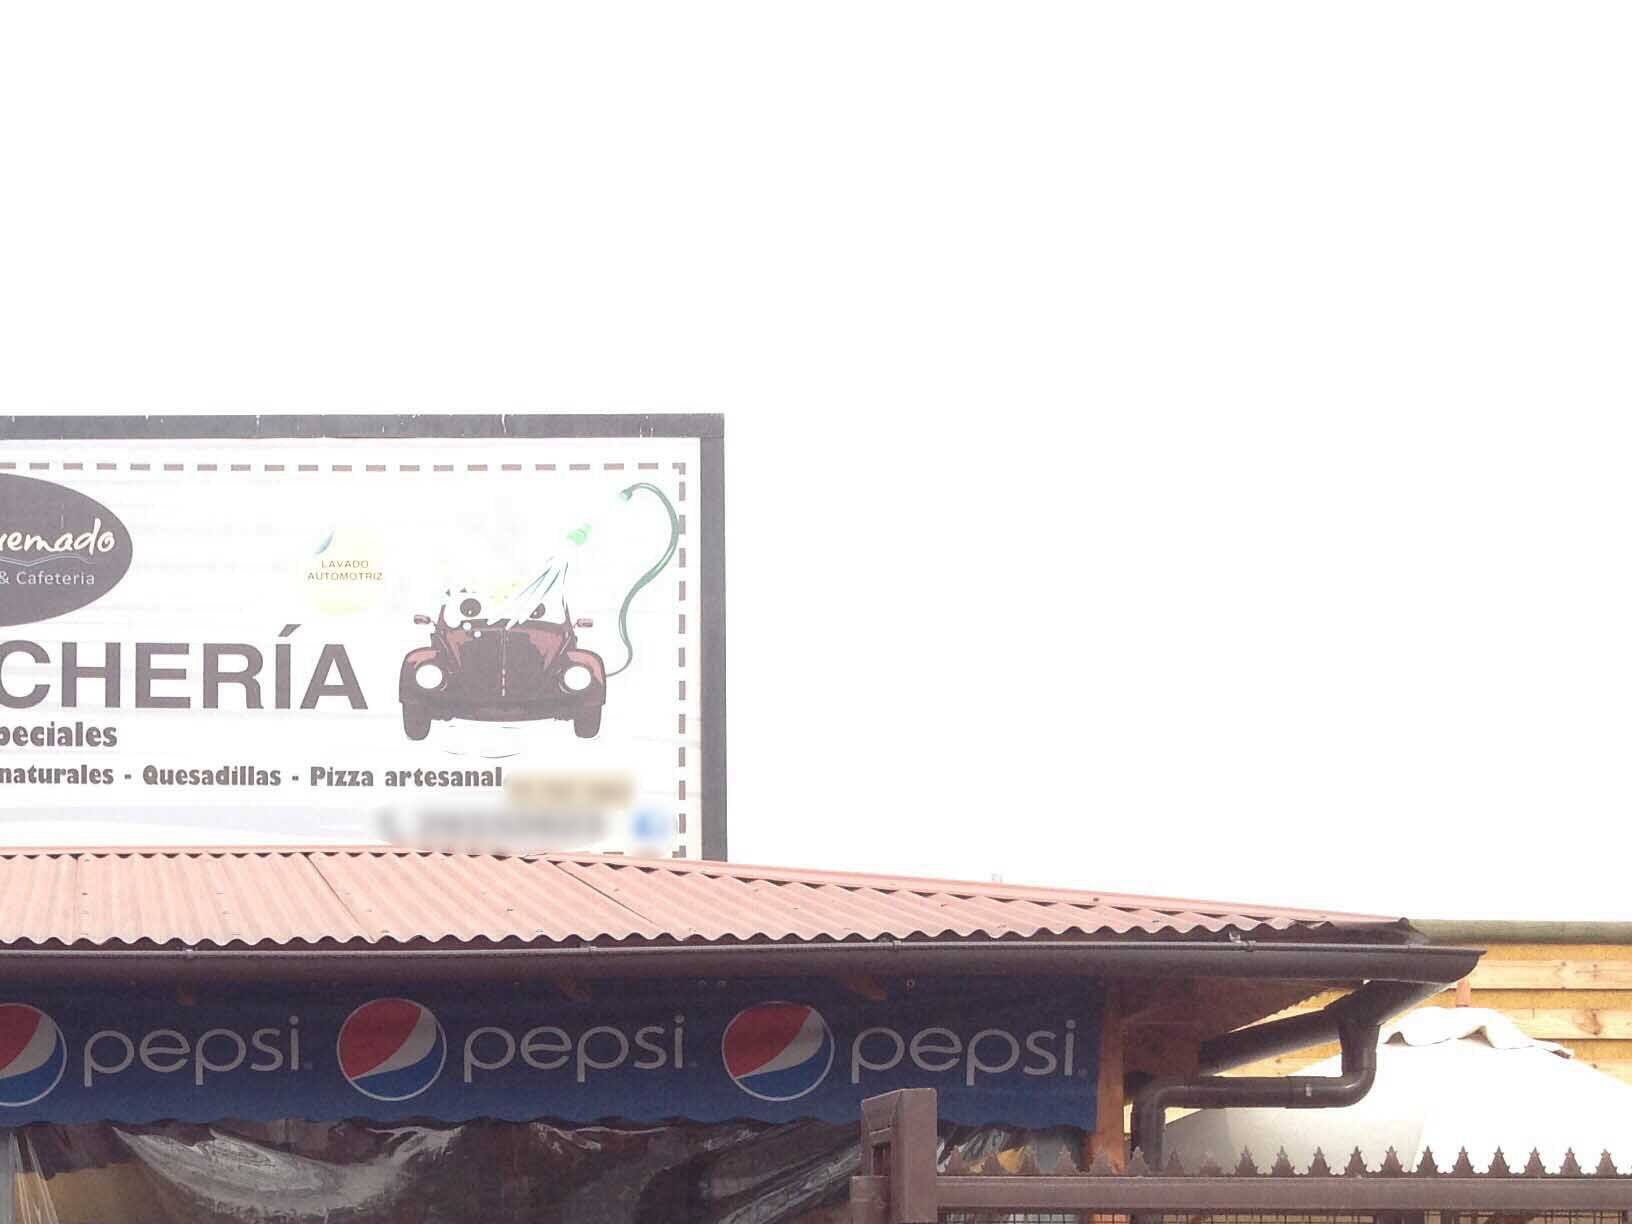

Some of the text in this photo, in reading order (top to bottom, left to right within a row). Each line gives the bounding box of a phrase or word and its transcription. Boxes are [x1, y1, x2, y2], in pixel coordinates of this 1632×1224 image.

[321, 559, 369, 569] LAVADO
[307, 571, 384, 582] AUTOMOTRIZ
[142, 765, 282, 787] Quesadillas
[310, 766, 374, 787] Pizza
[384, 766, 503, 788] artesanal
[83, 1015, 300, 1088] pepsi
[463, 1015, 685, 1083] pepsi
[851, 1019, 1076, 1086] pepsi
